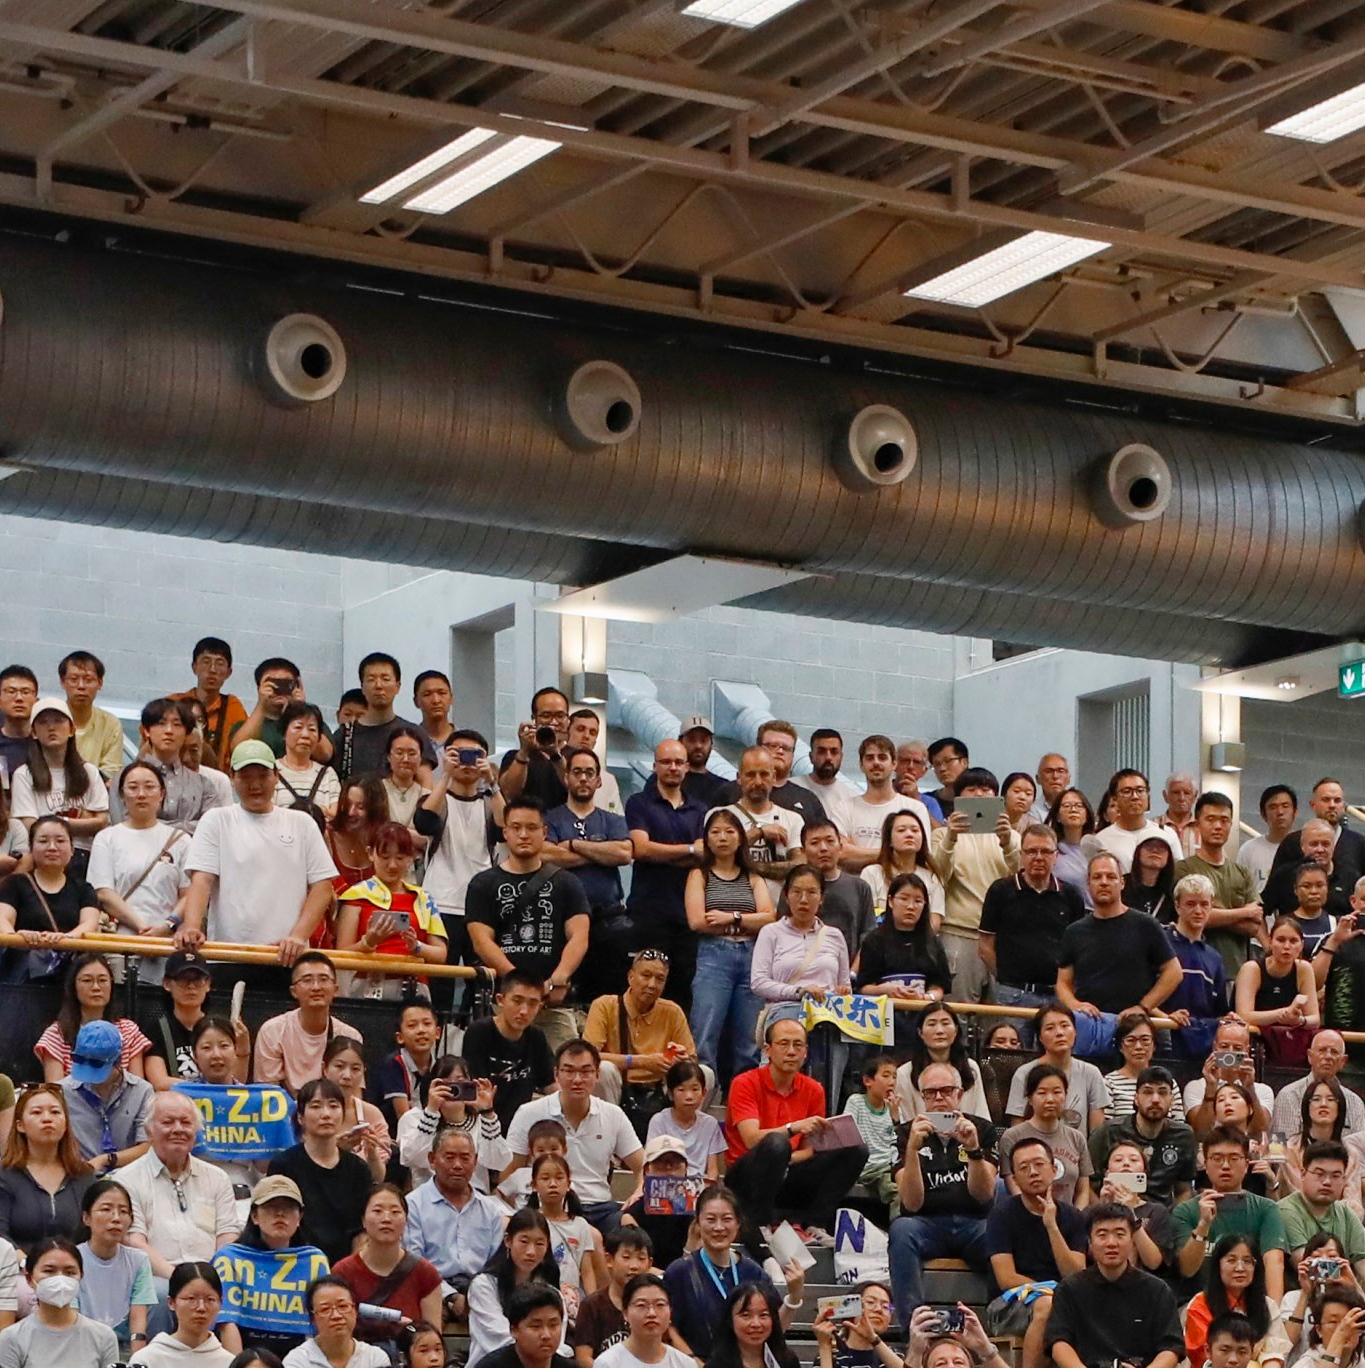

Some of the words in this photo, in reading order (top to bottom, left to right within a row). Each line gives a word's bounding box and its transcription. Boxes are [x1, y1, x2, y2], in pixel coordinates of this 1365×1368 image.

[527, 945, 538, 953] OF
[539, 945, 552, 954] ART
[226, 1285, 305, 1316] CHINA
